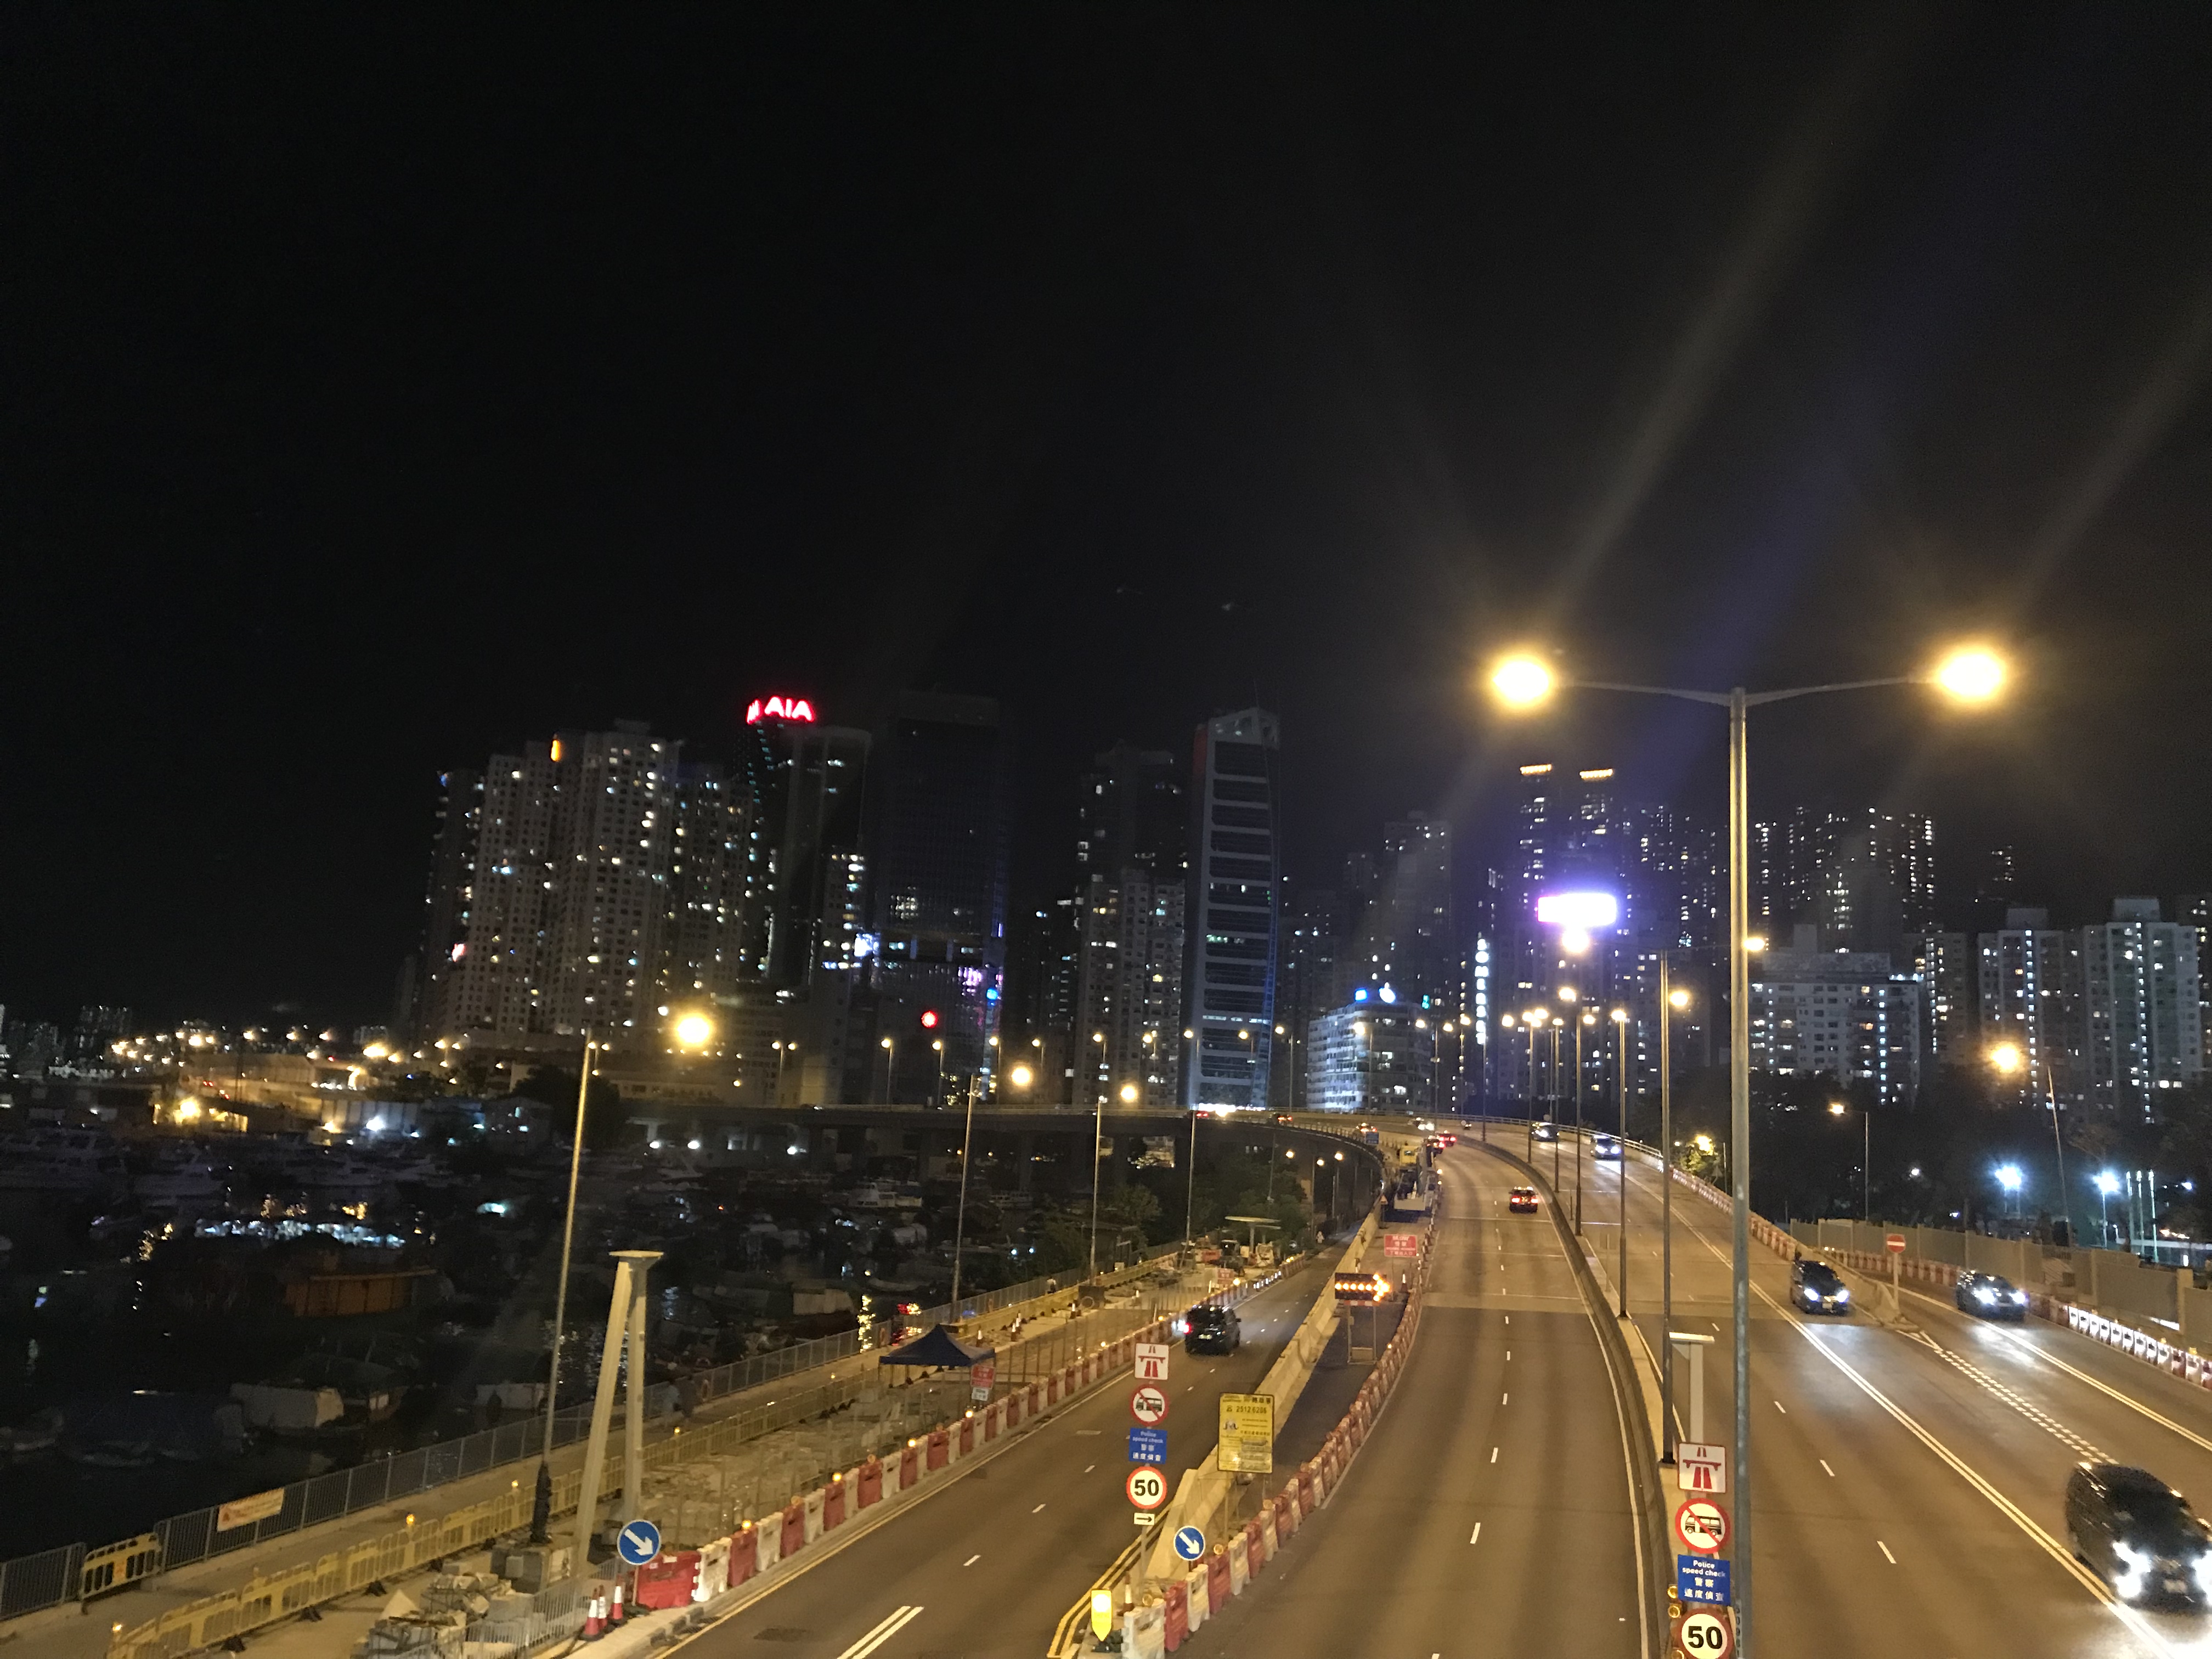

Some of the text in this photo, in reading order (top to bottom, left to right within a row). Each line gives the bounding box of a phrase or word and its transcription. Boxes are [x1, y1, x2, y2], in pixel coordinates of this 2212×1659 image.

[764, 695, 815, 723] AIA
[1134, 1479, 1159, 1497] 50
[1693, 1560, 1715, 1569] Police
[1688, 1626, 1723, 1650] 50
